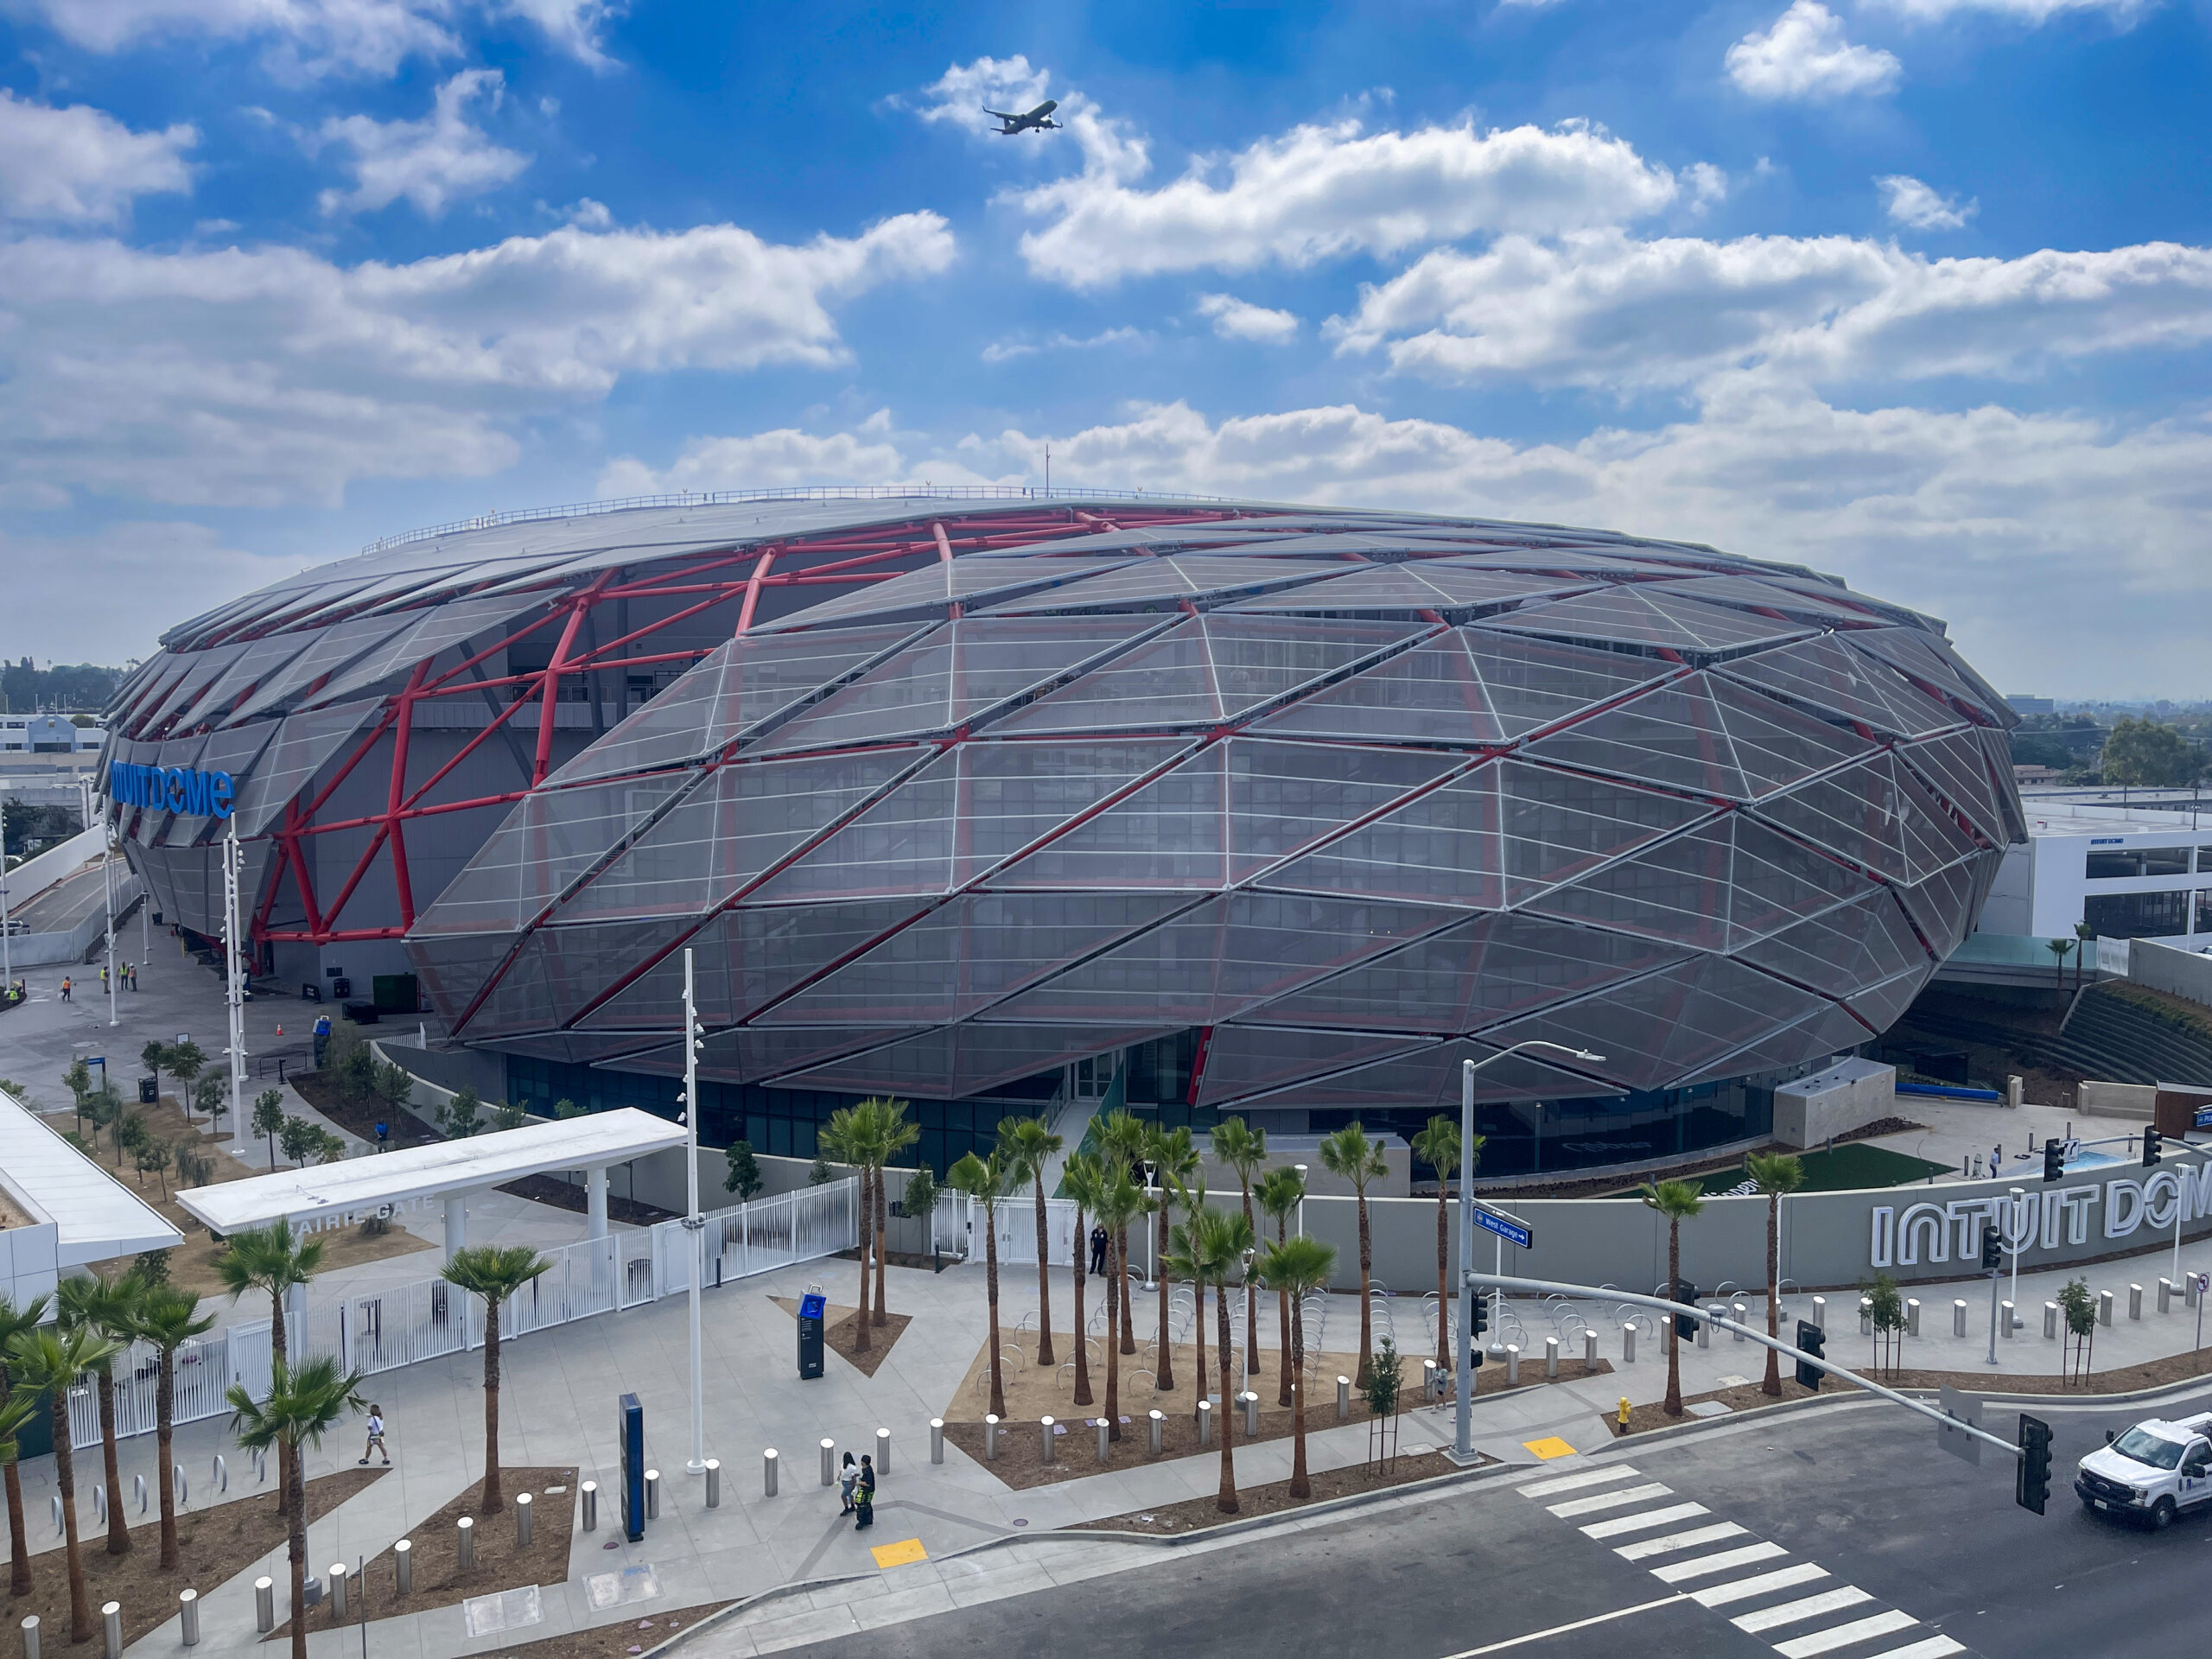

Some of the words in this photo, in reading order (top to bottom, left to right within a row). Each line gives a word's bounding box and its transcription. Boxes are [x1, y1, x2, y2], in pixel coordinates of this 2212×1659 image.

[376, 1194, 435, 1220] GATE
[1485, 1217, 1498, 1229] West
[1500, 1224, 1518, 1238] Garage
